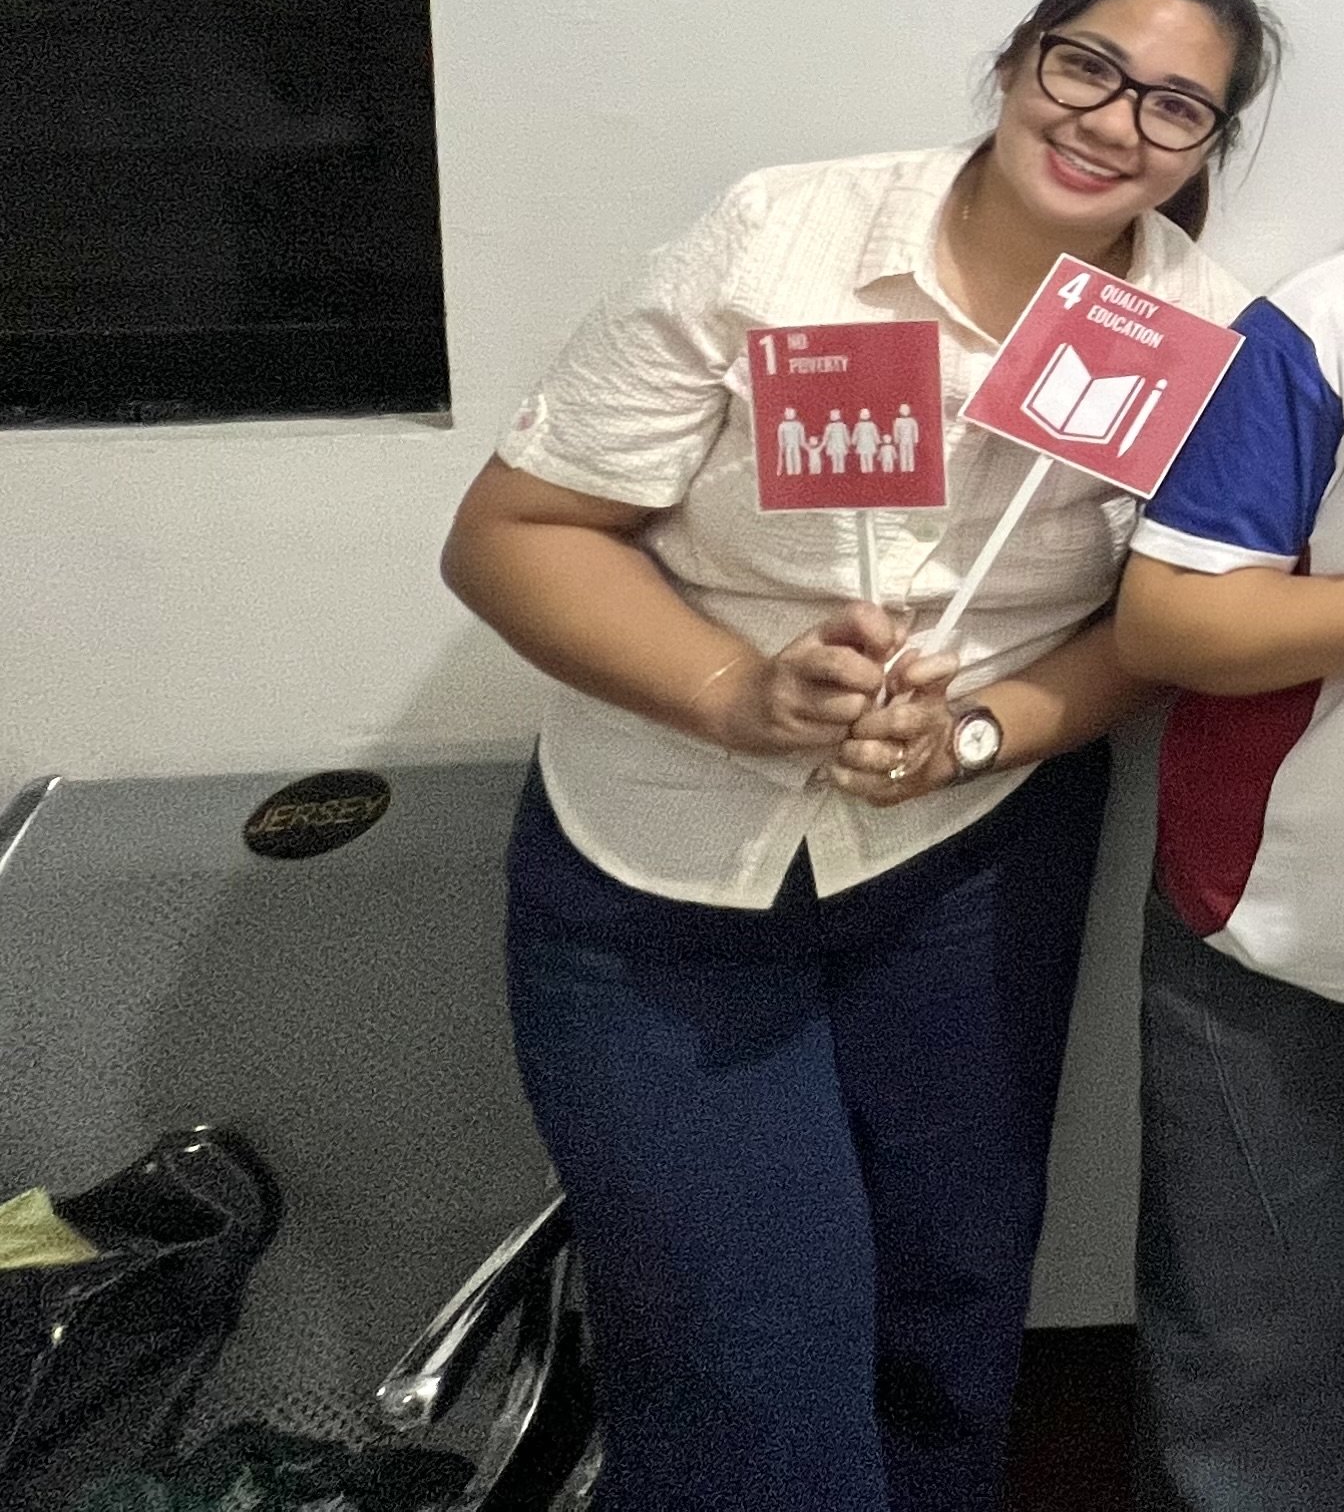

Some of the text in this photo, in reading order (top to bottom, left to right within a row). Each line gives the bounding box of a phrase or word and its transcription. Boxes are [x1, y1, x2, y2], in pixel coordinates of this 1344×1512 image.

[1057, 273, 1091, 310] 4
[1101, 284, 1160, 319] QUALITY
[1086, 304, 1164, 349] EDUCATION
[759, 334, 777, 375] 1
